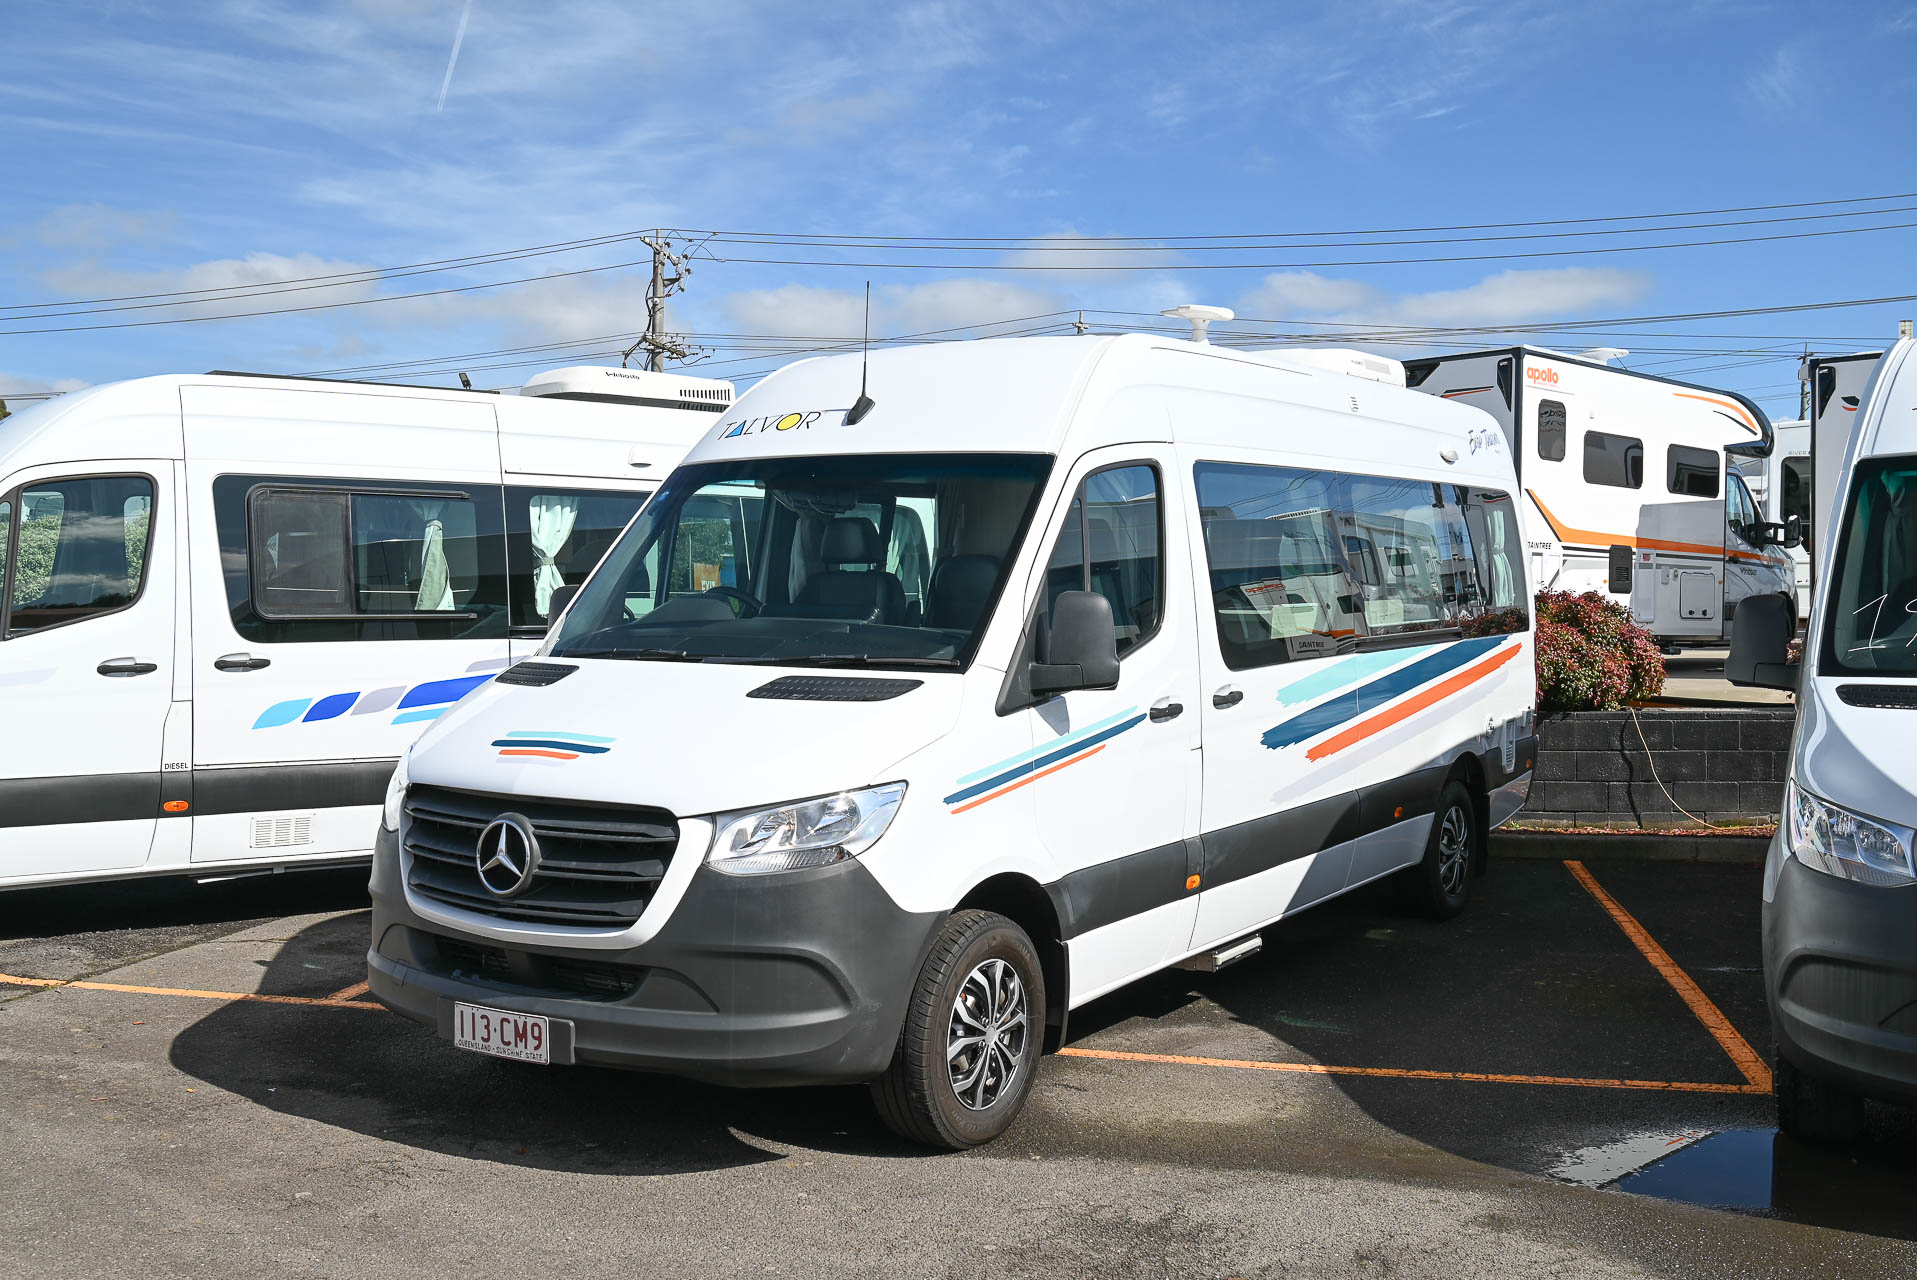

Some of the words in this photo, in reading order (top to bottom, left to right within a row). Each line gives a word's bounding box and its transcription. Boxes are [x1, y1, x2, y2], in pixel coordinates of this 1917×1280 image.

[1526, 366, 1559, 384] apollo
[717, 411, 822, 440] TALVOR
[164, 762, 189, 770] DIESEL
[458, 1039, 492, 1052] QUEENSLAND
[496, 1047, 523, 1058] SUNSHINE
[525, 1052, 544, 1060] STATE
